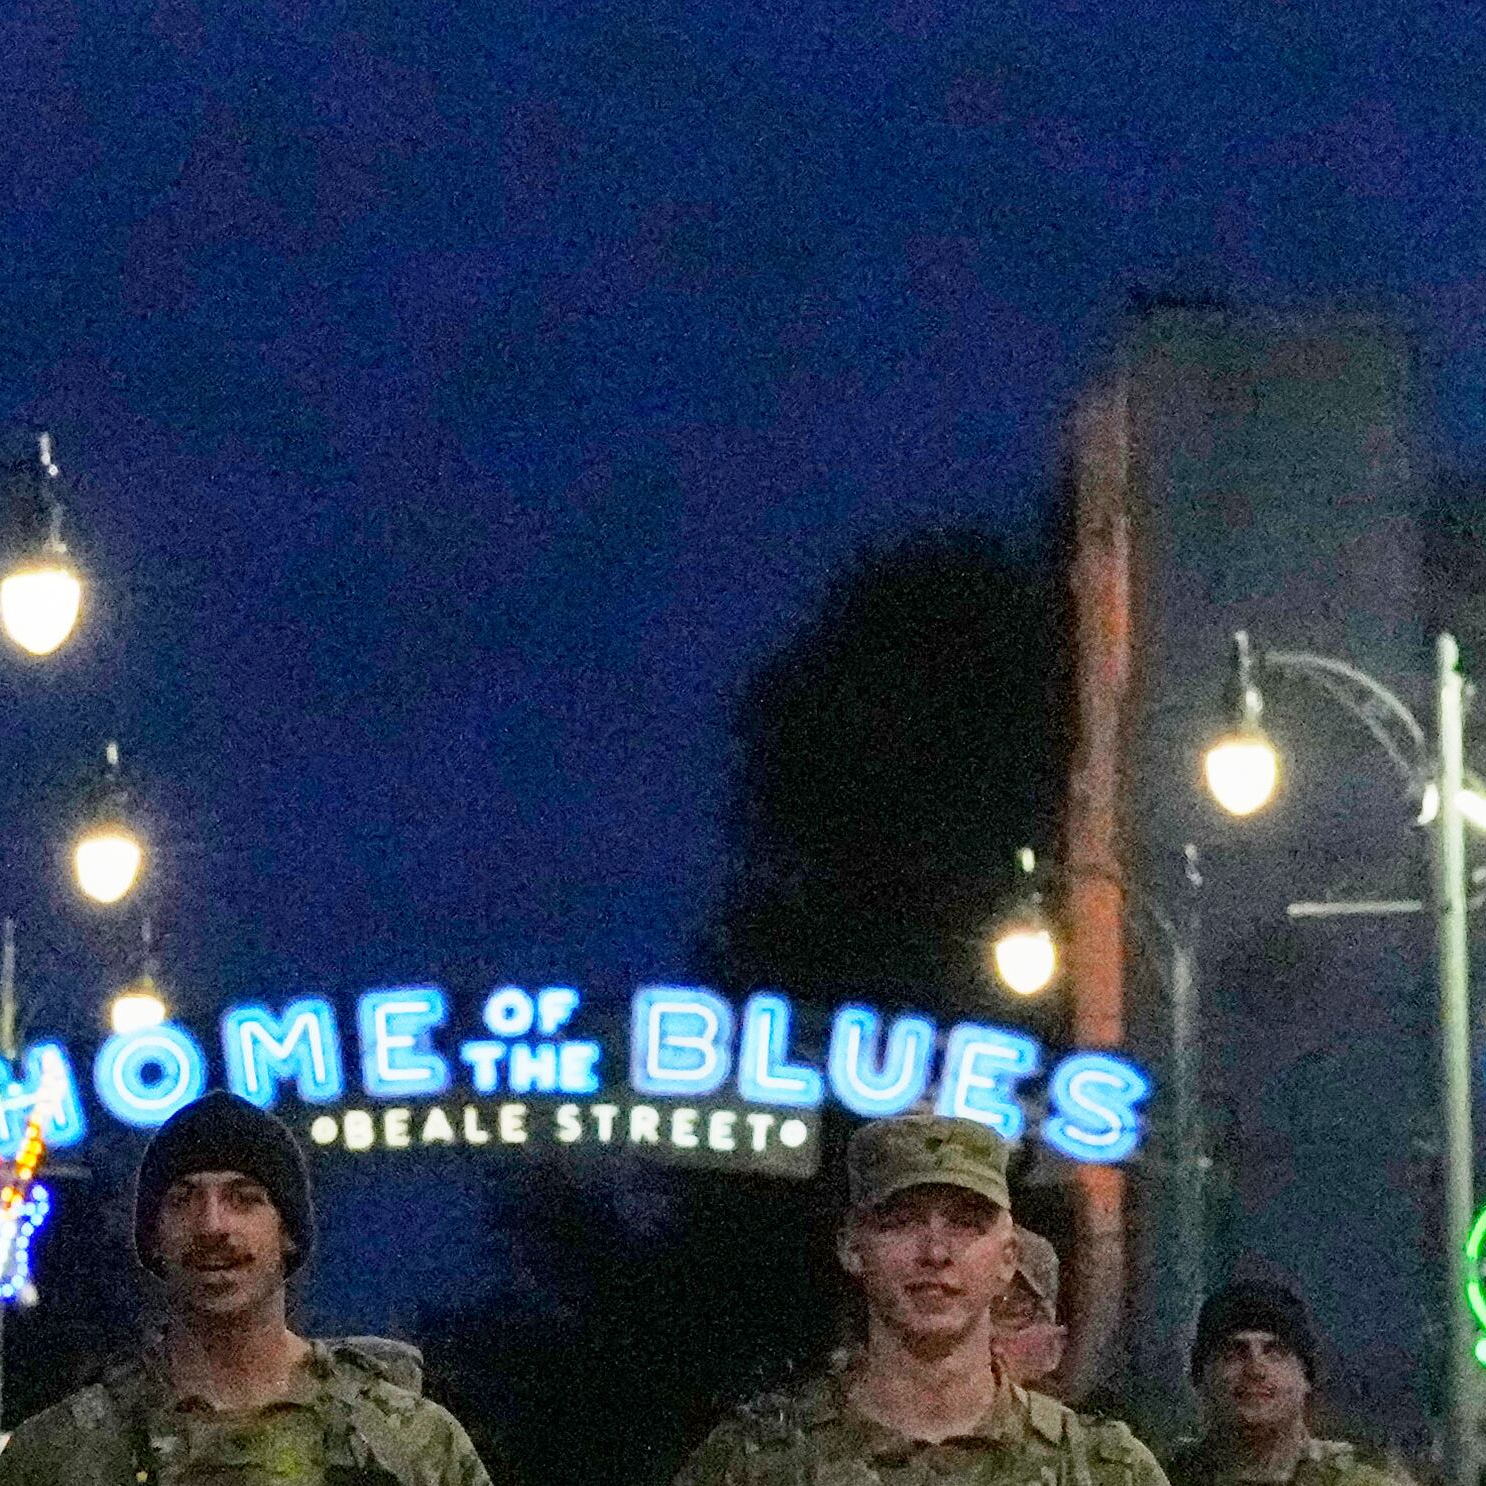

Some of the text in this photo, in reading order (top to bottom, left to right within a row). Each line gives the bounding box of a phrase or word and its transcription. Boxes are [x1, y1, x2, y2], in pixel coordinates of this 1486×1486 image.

[483, 985, 581, 1037] OF
[460, 1039, 600, 1094] THE
[631, 985, 1153, 1165] BLUES
[342, 1102, 775, 1153] BEALE STREET
